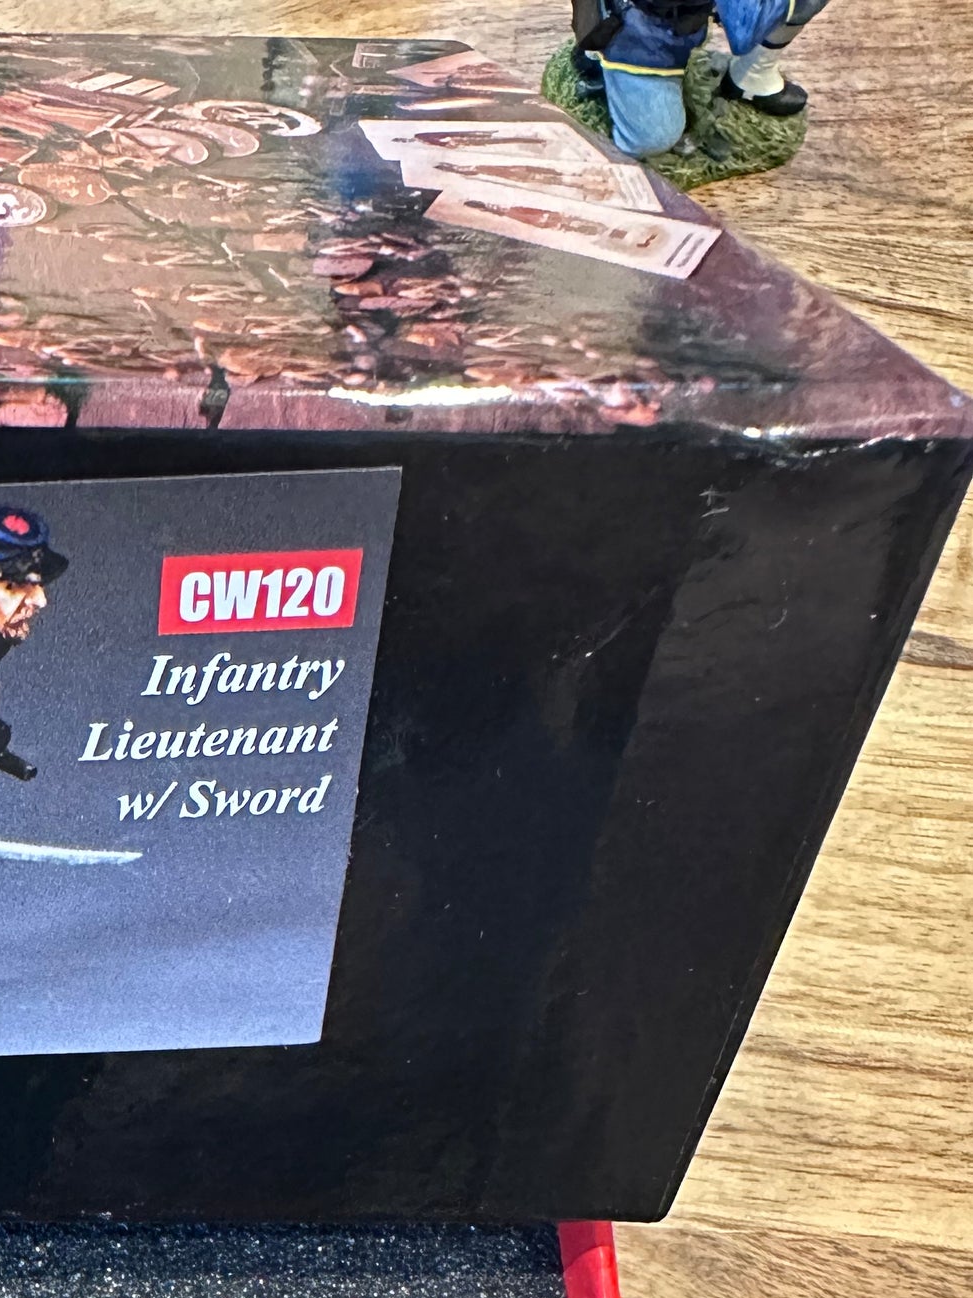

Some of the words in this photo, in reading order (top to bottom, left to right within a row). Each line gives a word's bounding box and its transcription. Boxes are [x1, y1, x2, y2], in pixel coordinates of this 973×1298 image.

[179, 566, 346, 622] CW120
[140, 652, 346, 706] Infantry
[77, 717, 339, 762] Lieutenant
[117, 781, 178, 821] w/
[179, 774, 333, 819] Sword
